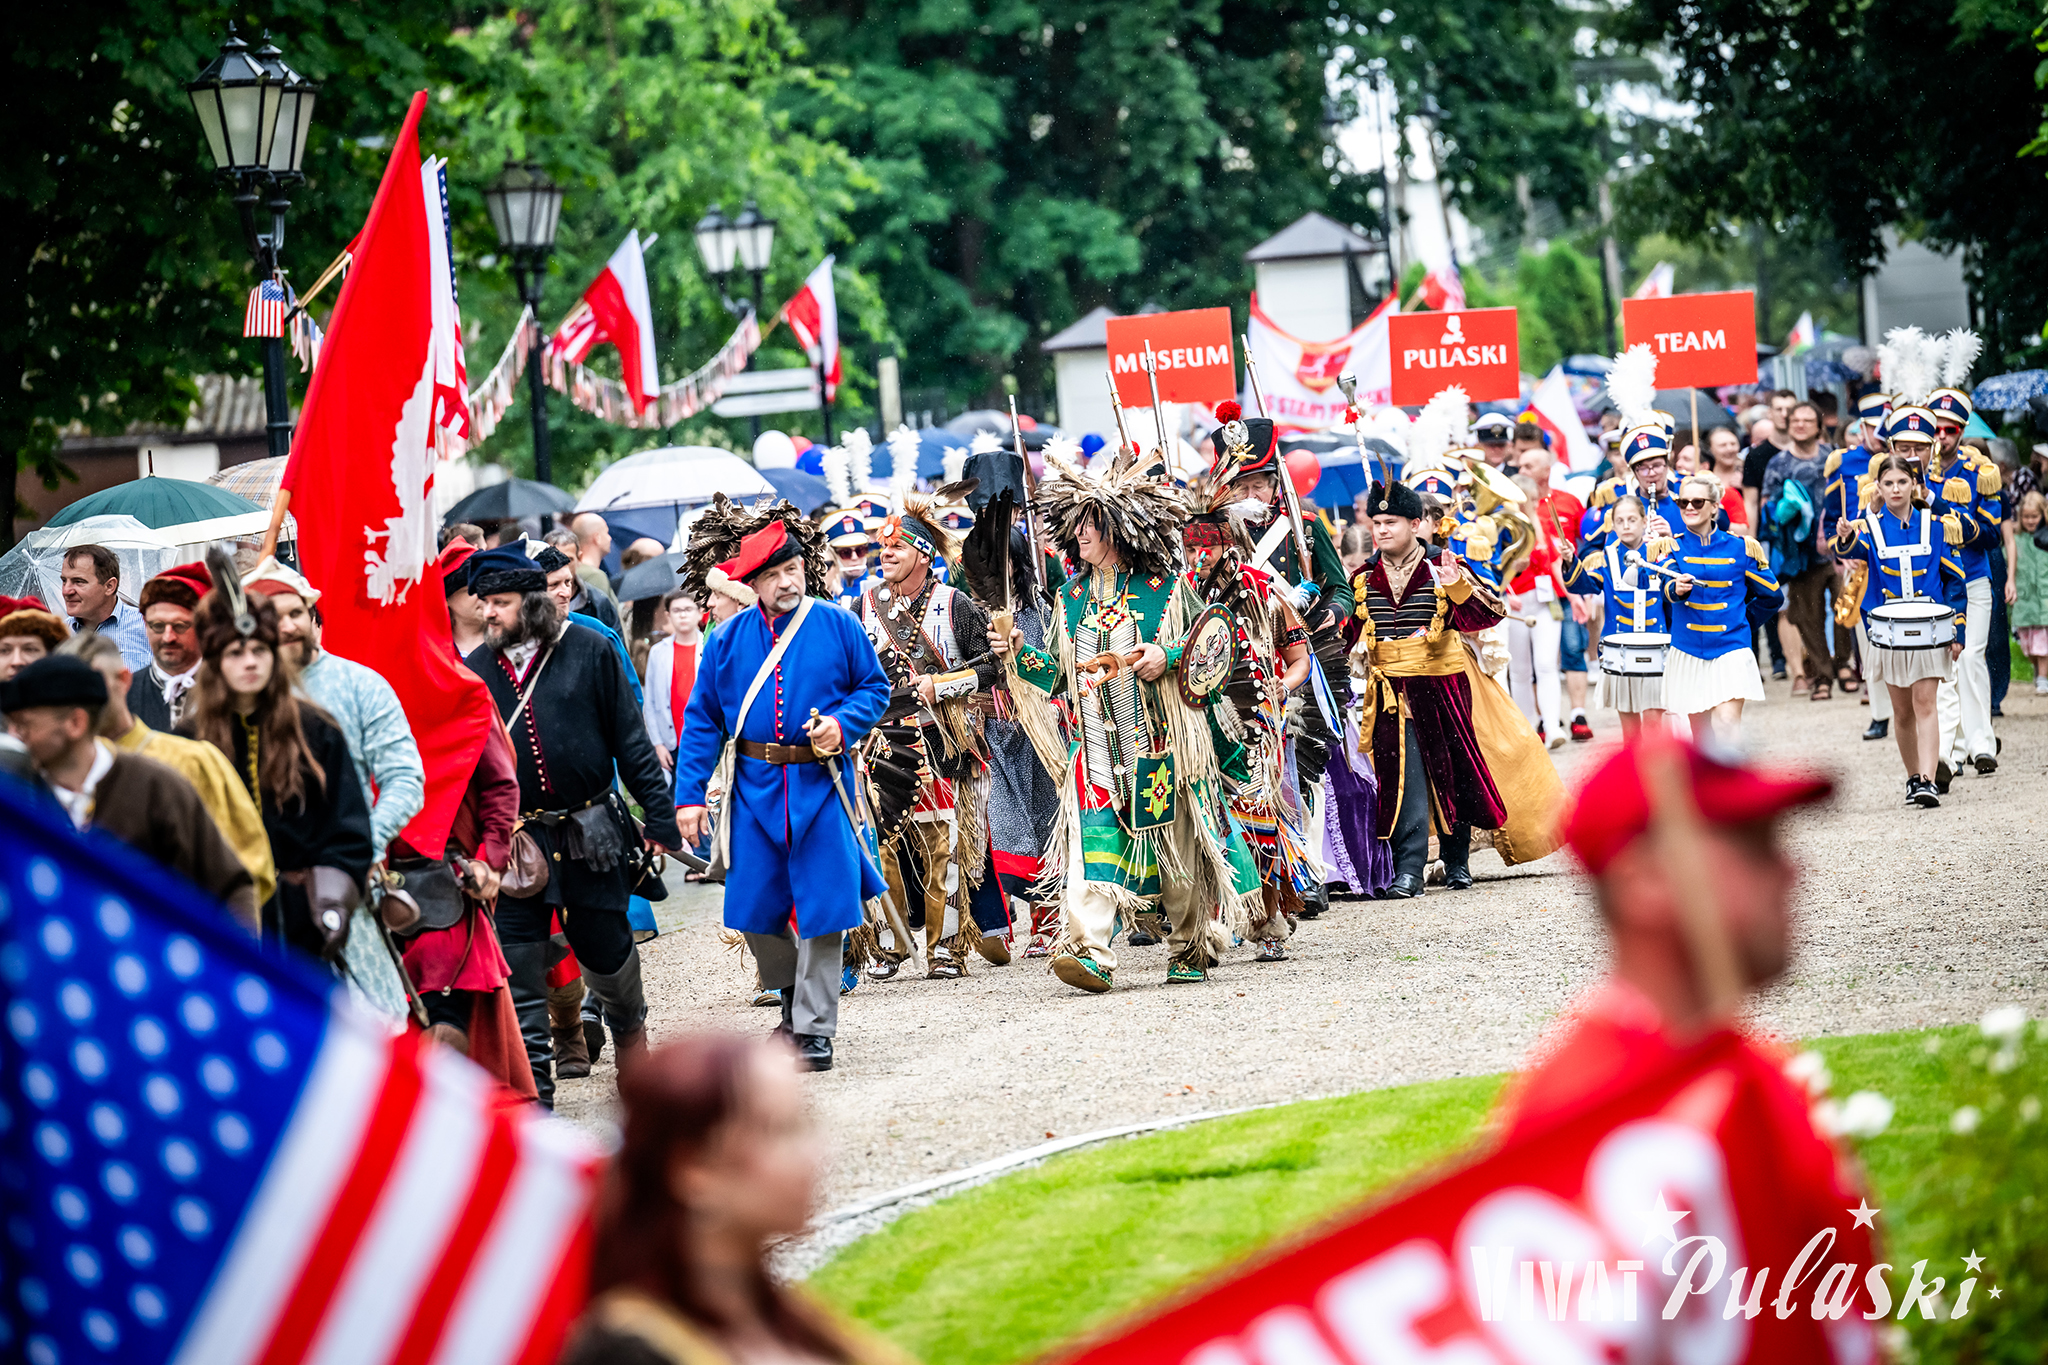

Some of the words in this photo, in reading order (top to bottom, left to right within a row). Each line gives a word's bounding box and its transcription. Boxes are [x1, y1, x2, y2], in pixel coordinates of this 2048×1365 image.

[1654, 329, 1726, 354] TEAM
[1115, 345, 1229, 374] MUSEUM
[1403, 344, 1507, 370] PULASKI
